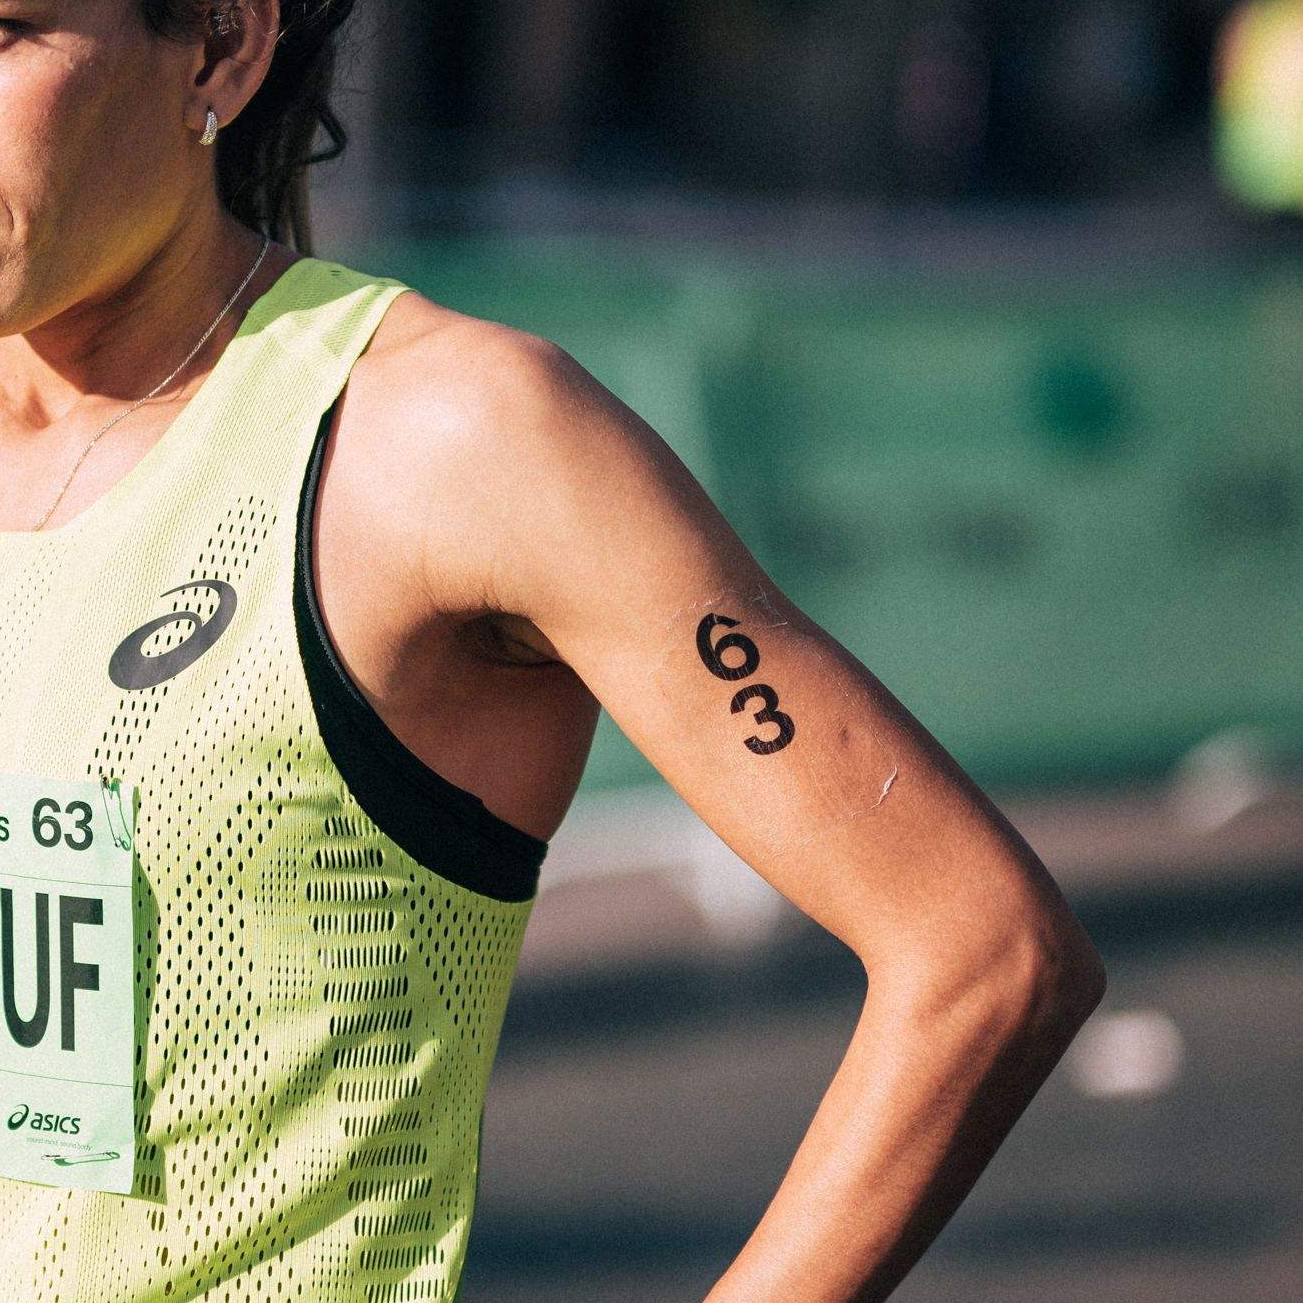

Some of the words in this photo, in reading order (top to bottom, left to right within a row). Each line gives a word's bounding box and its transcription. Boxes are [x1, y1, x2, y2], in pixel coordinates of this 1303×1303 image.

[696, 613, 795, 755] 63
[32, 797, 94, 851] 63
[30, 1112, 81, 1135] asics
